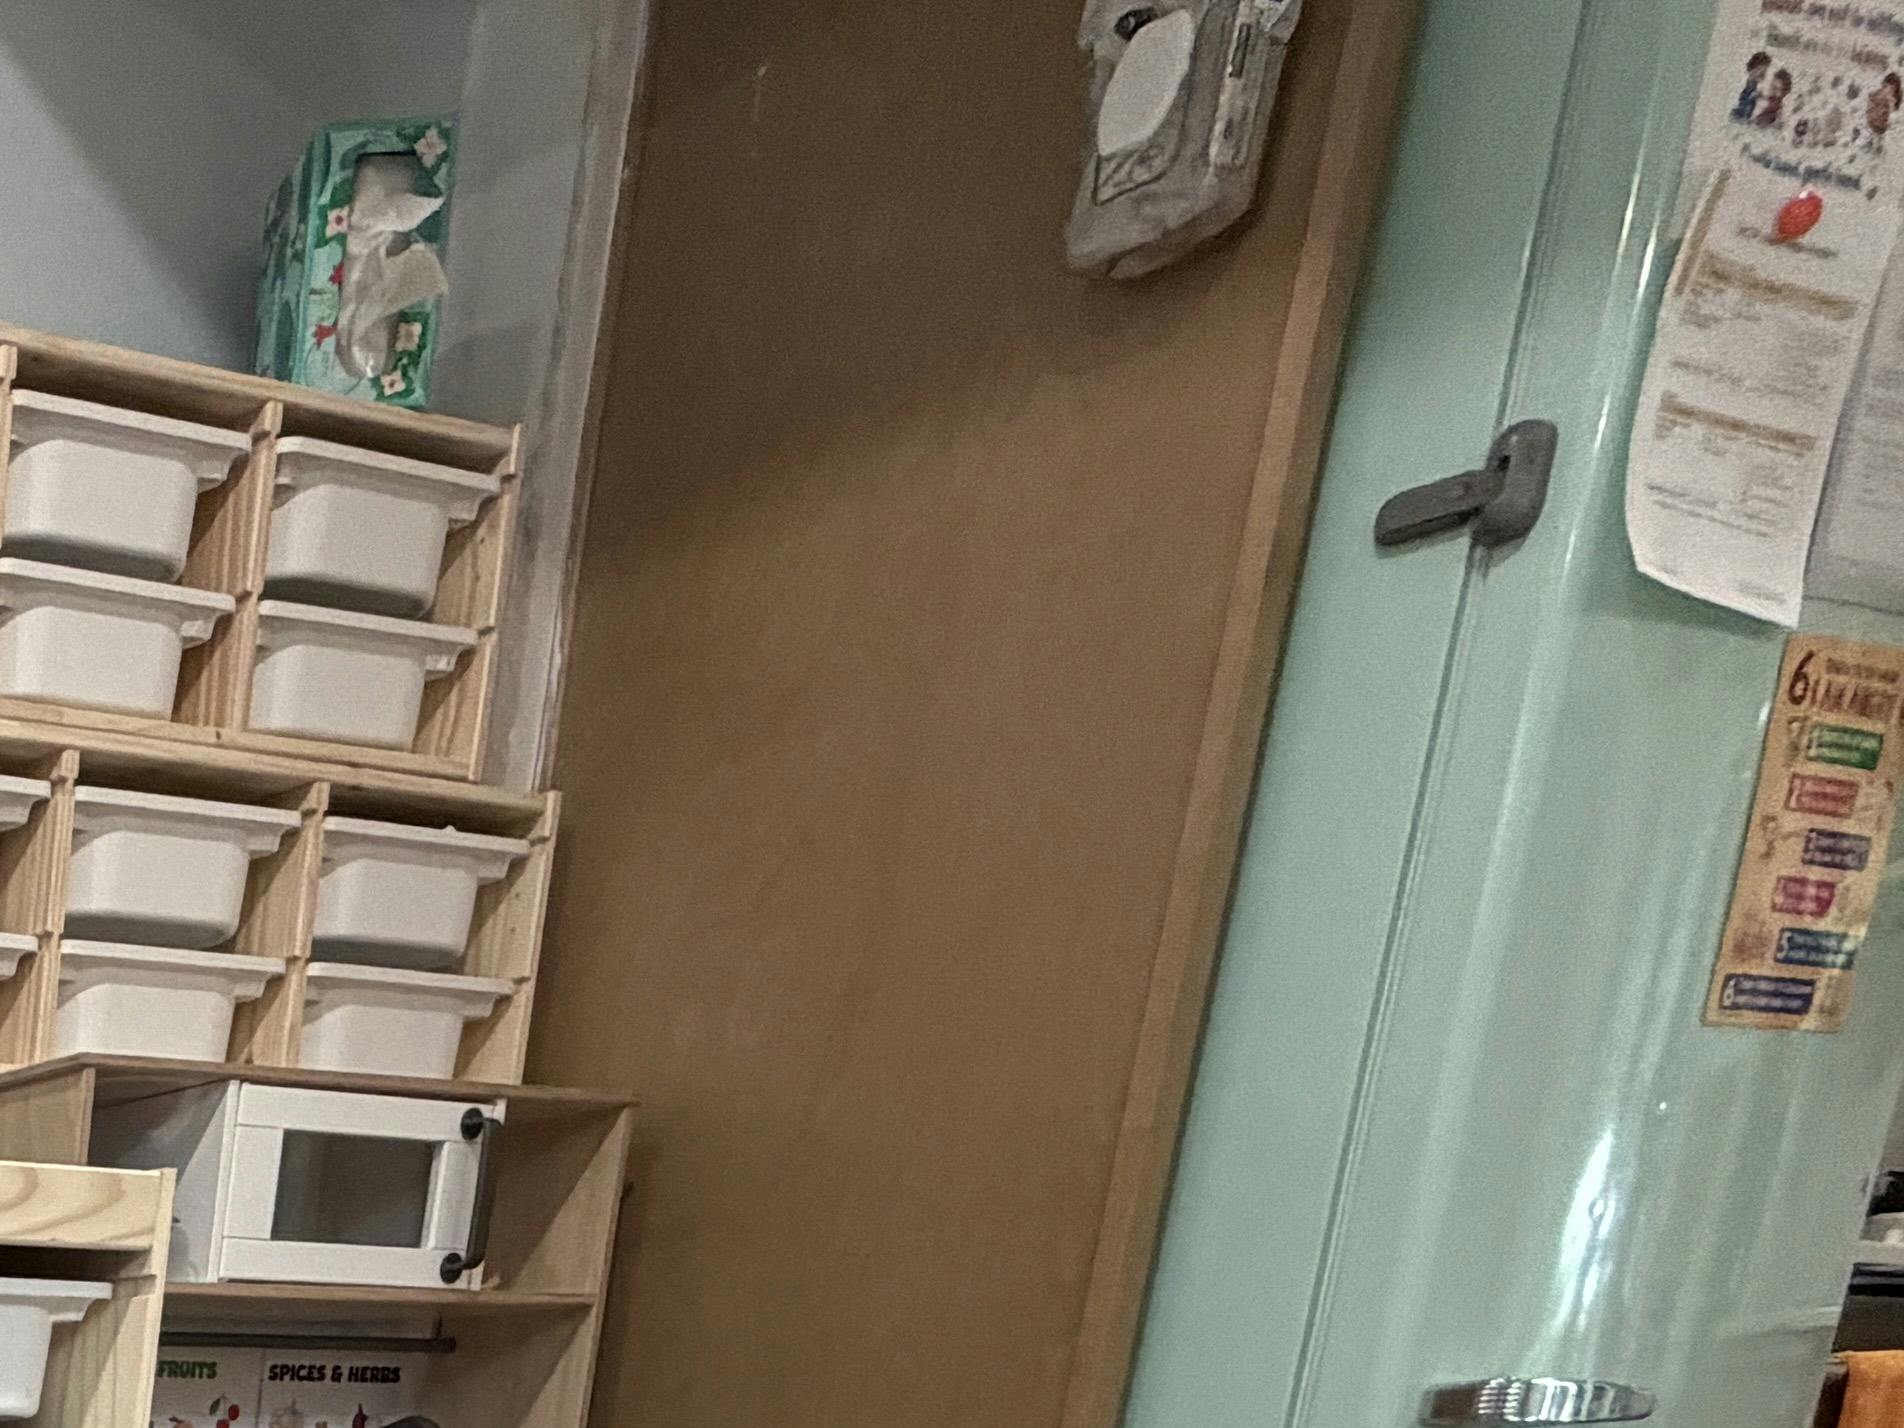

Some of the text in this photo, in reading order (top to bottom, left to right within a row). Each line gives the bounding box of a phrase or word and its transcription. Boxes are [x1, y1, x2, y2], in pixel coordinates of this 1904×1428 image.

[158, 1361, 217, 1380] FRUITS
[268, 1364, 401, 1383] SPICES & HERBS
